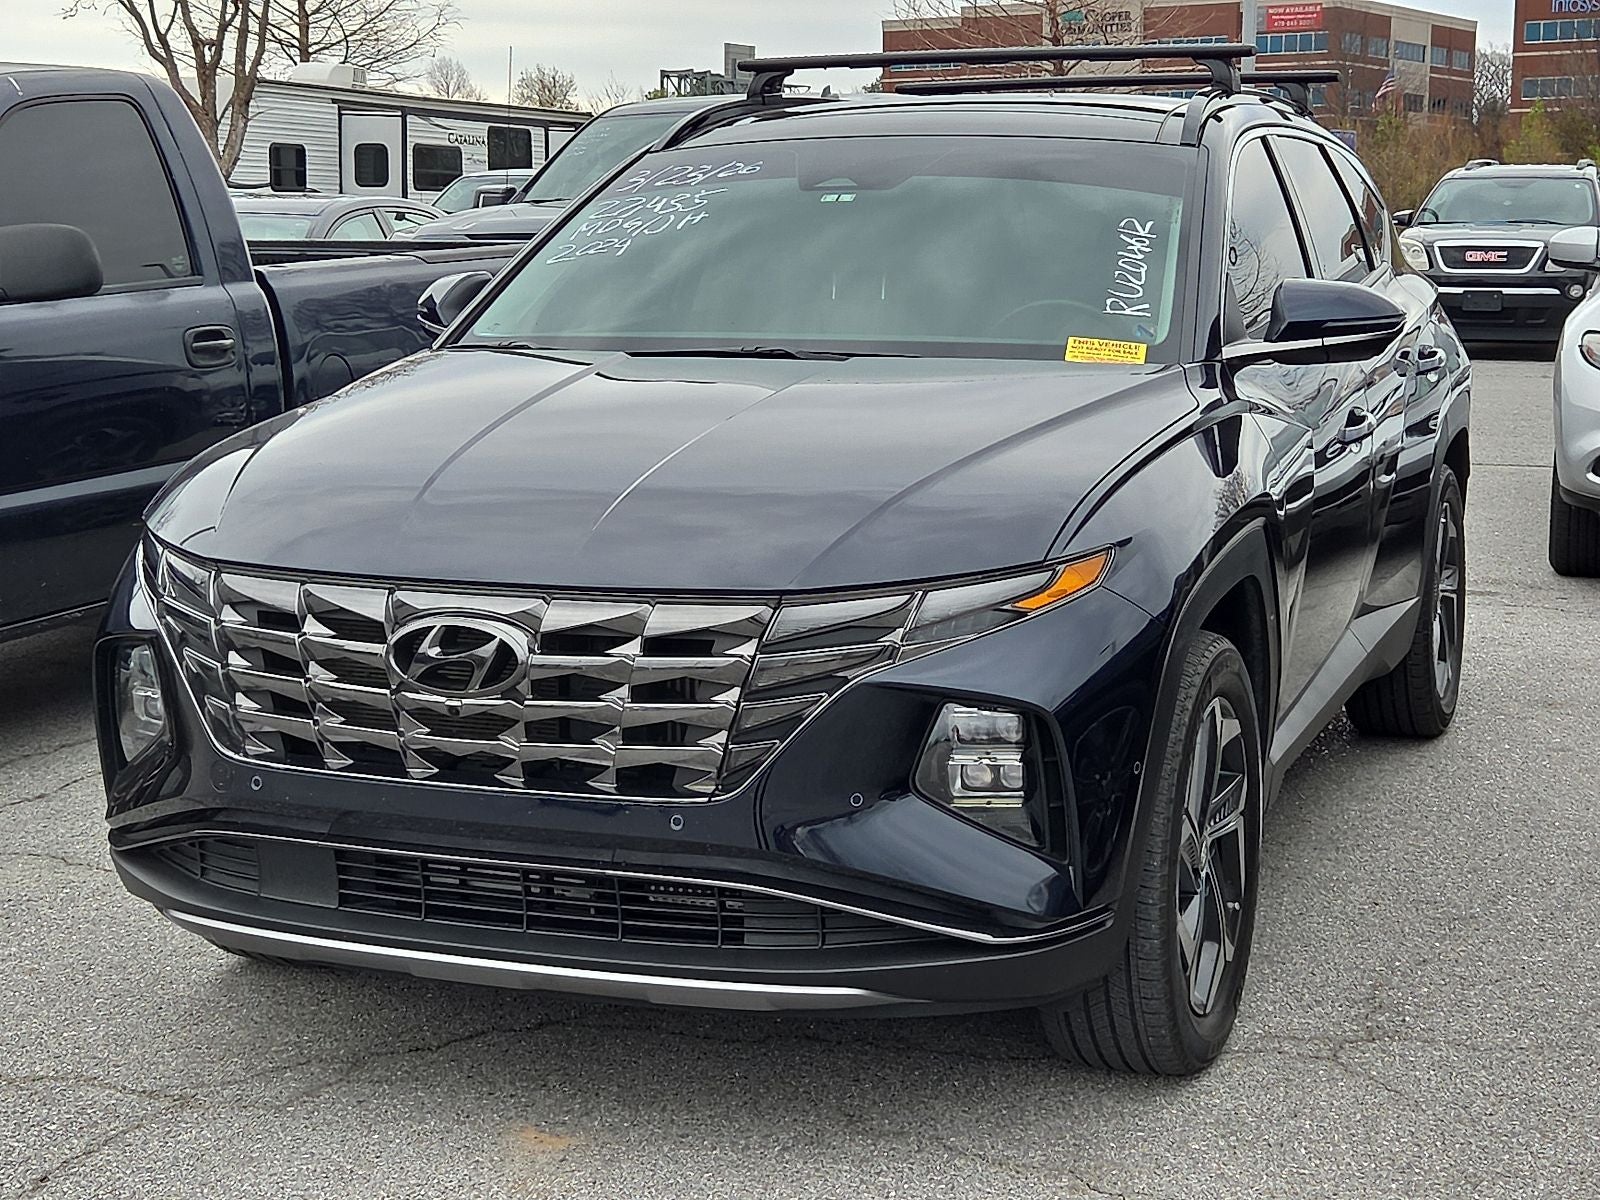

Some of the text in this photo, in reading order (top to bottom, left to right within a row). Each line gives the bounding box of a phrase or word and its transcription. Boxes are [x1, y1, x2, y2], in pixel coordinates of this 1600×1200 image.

[1285, 5, 1321, 13] AVAILABLE
[448, 133, 486, 146] CATALINA
[616, 161, 764, 193] 3/23/26
[546, 238, 631, 265] 2024
[1465, 250, 1508, 262] GMC
[1098, 341, 1140, 350] VEHICLE
